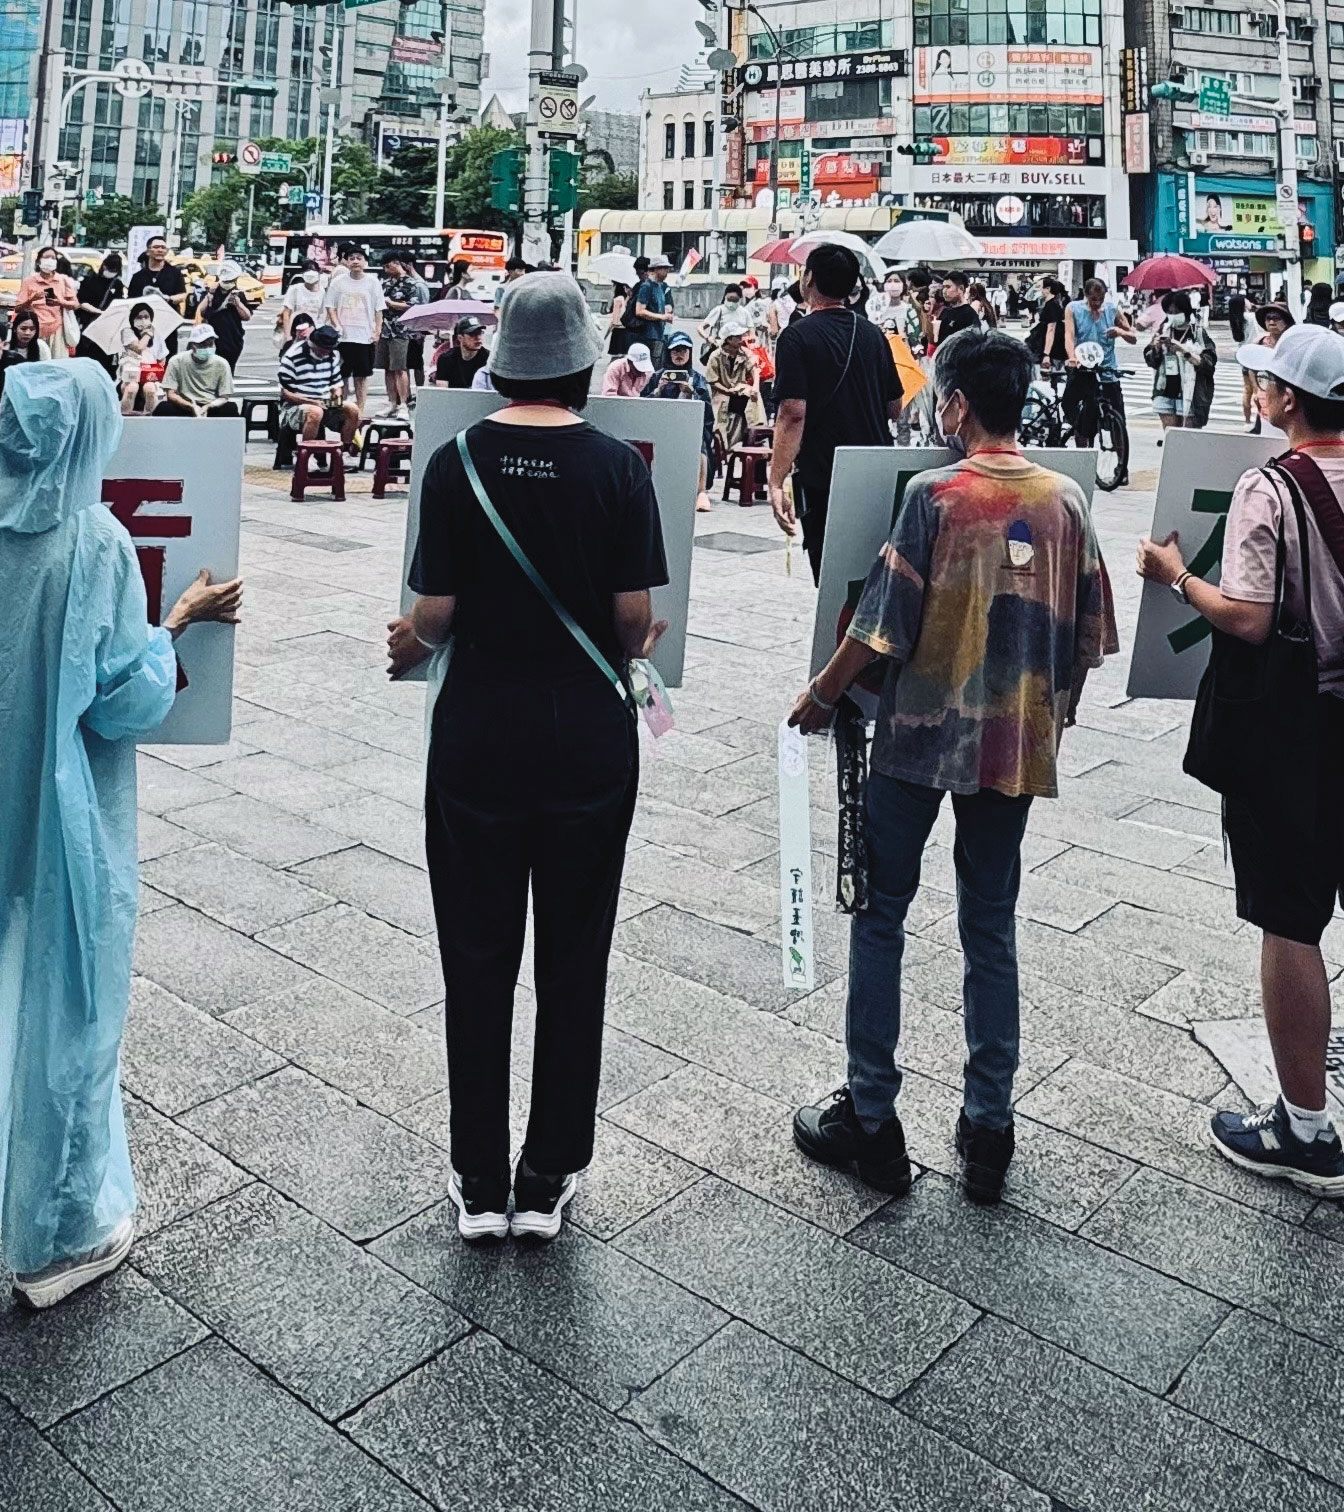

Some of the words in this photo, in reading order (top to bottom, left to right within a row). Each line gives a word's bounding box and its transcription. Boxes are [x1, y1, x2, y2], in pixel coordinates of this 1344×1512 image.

[931, 172, 1010, 185] 日本最大二手店
[1215, 236, 1261, 251] watsons
